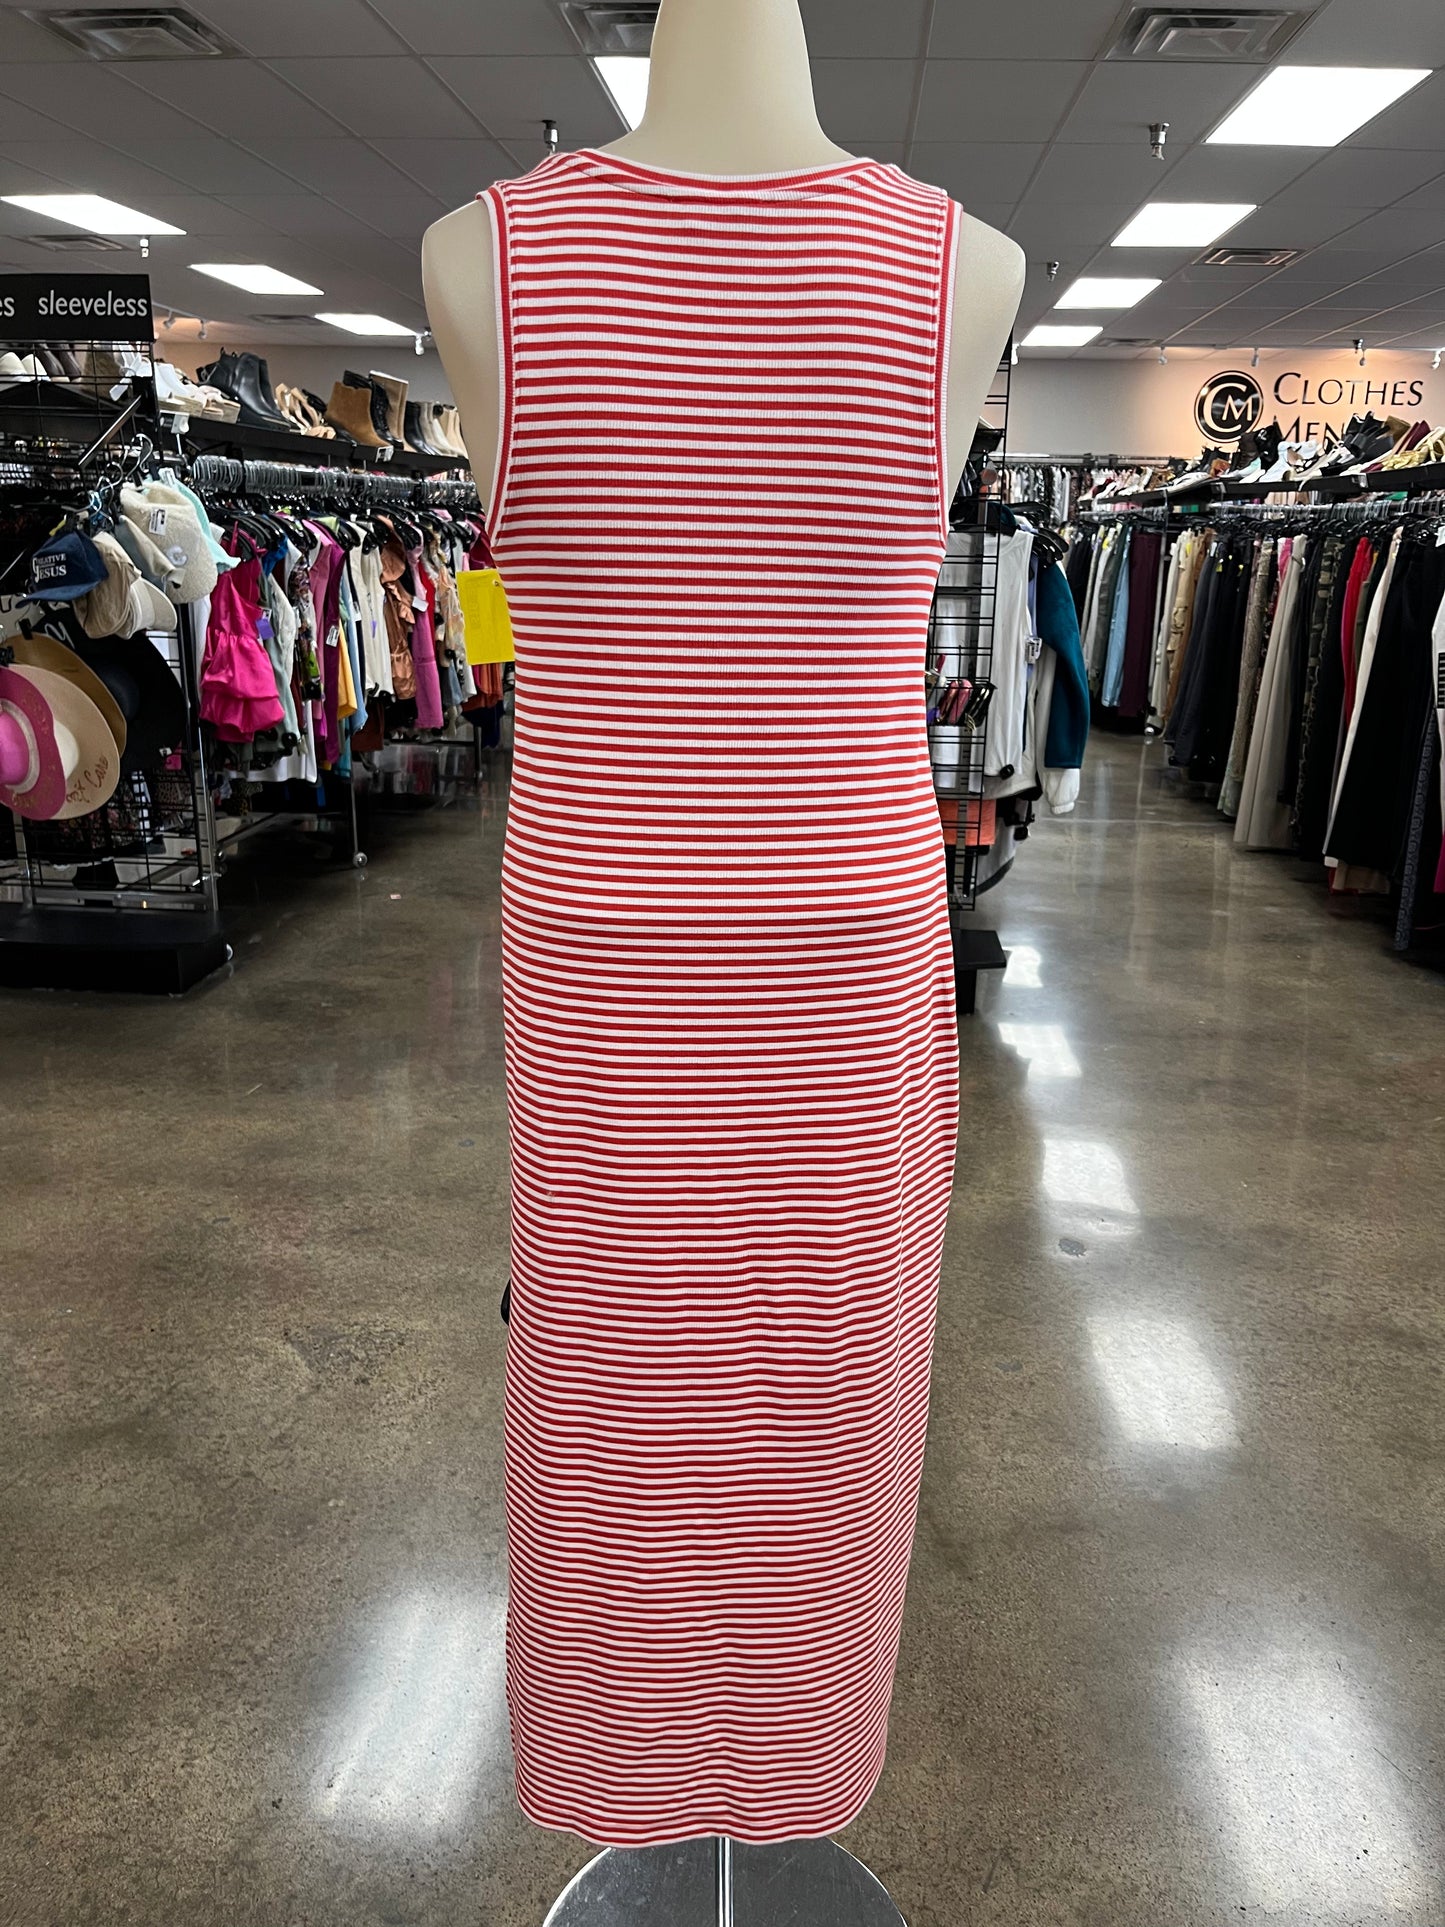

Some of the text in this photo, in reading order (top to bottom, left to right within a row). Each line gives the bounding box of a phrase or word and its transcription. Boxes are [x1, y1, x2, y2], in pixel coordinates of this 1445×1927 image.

[38, 289, 148, 317] sleeveless
[1273, 372, 1424, 407] CLOTHES
[1273, 415, 1346, 447] MEN
[34, 565, 67, 583] JESUS
